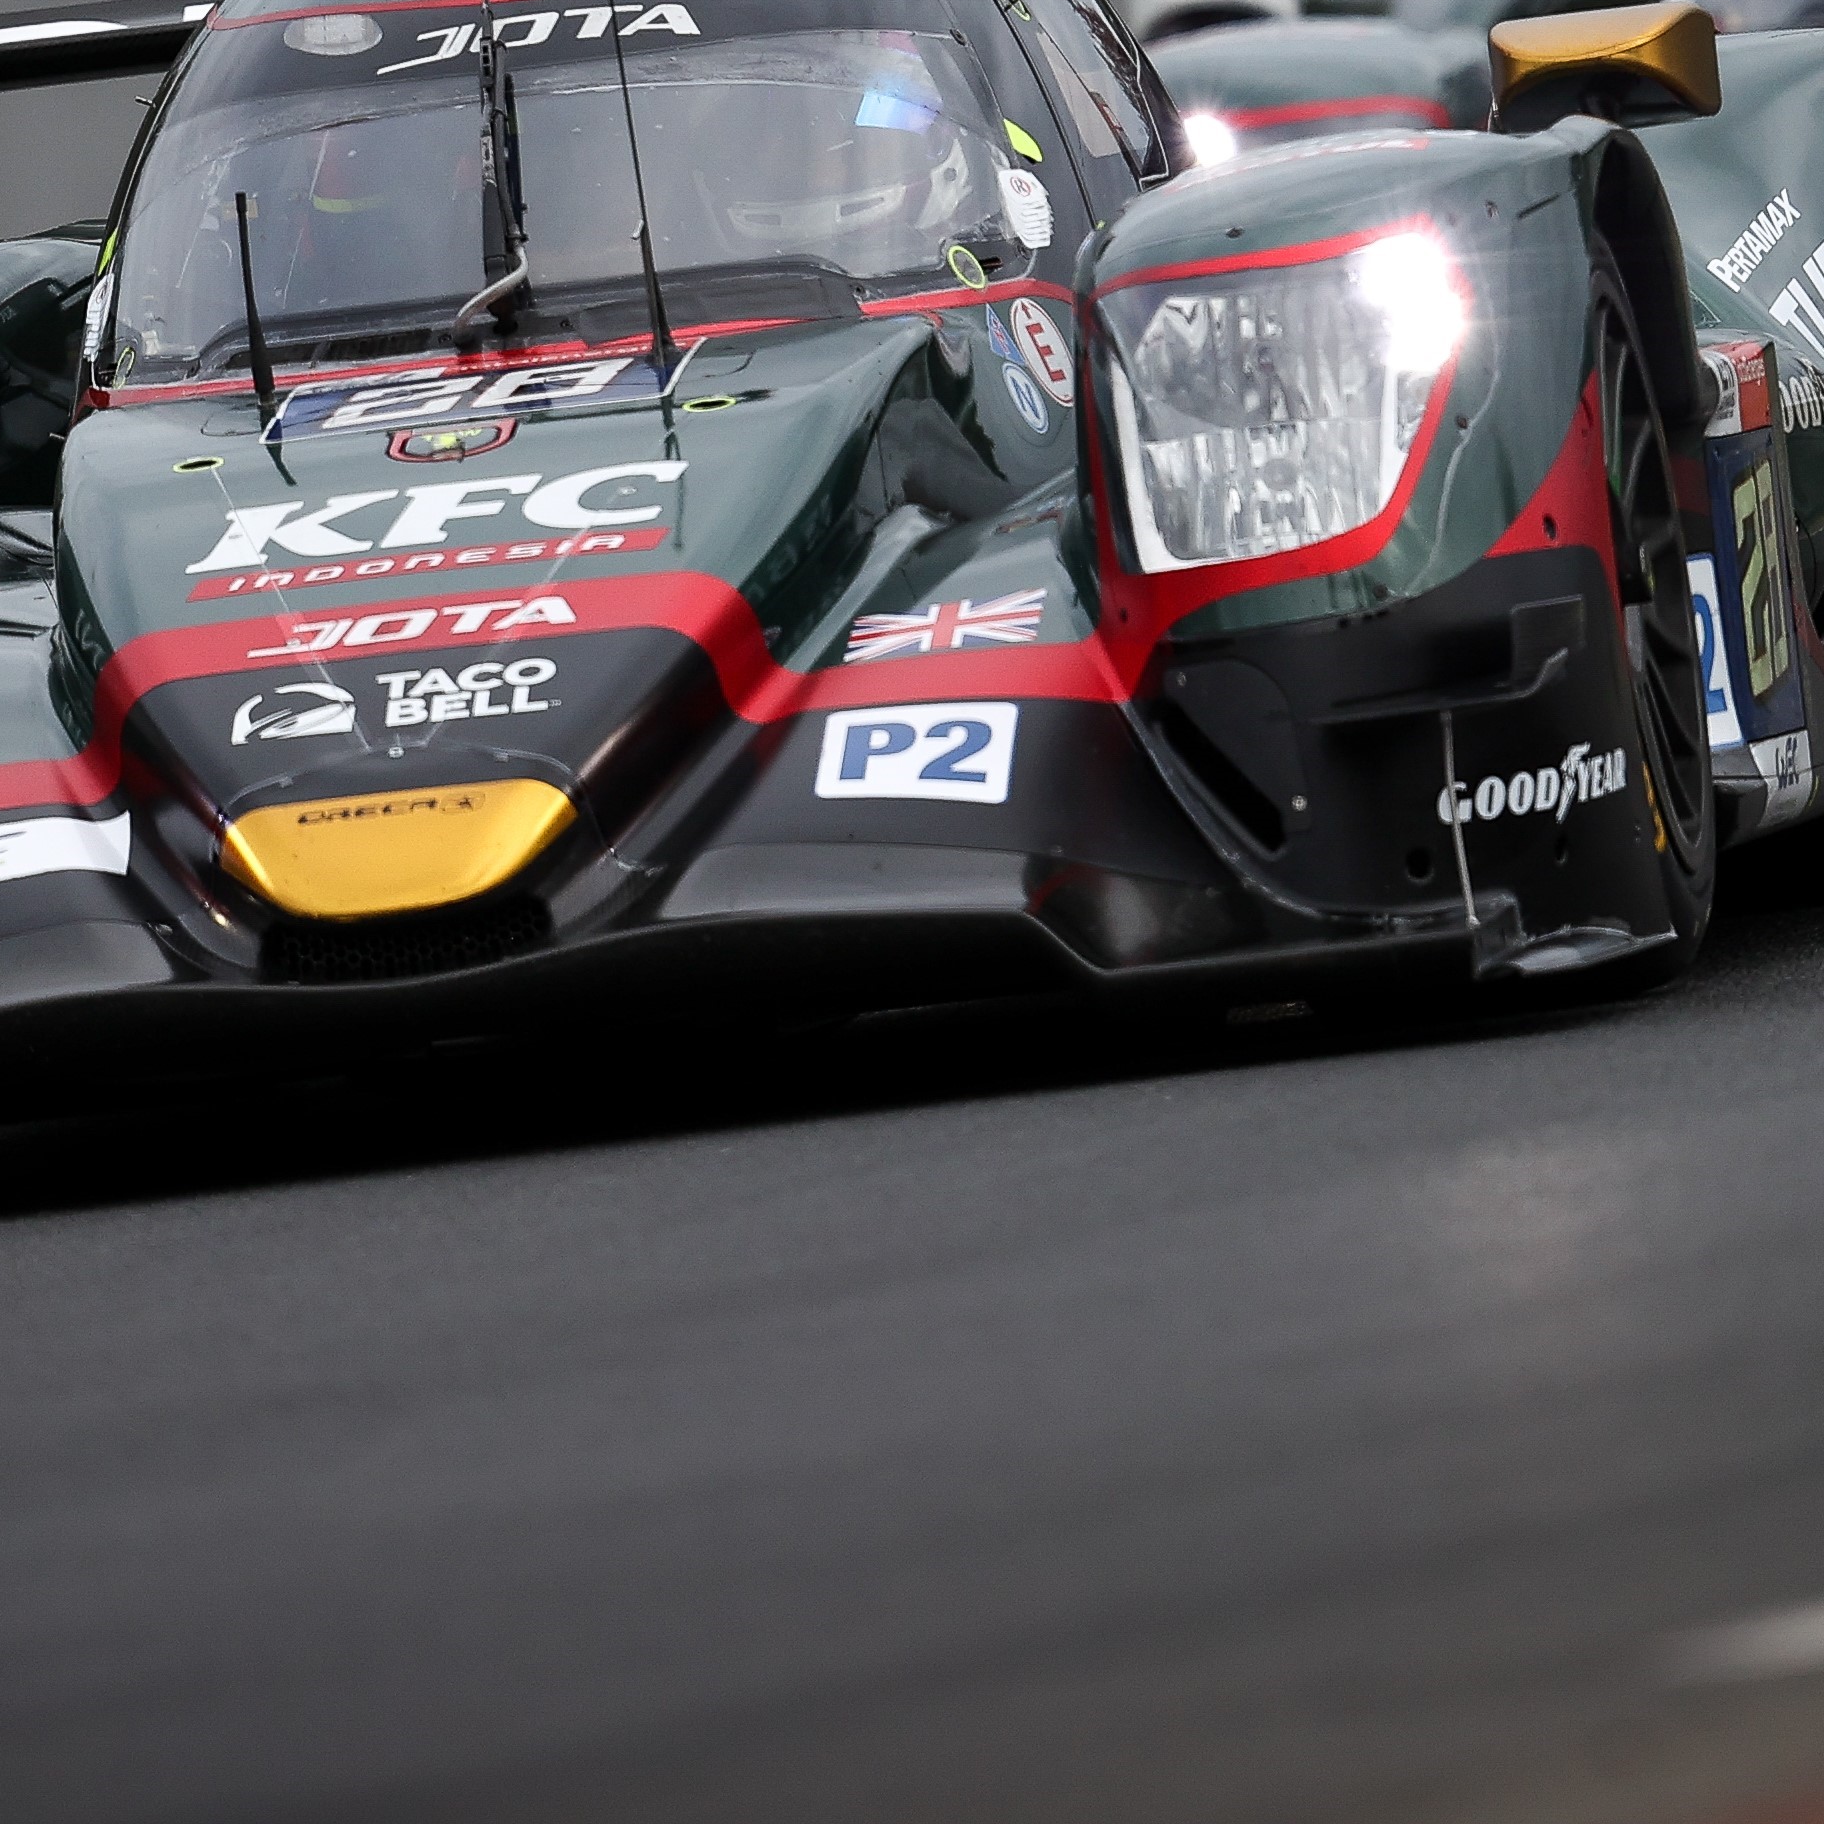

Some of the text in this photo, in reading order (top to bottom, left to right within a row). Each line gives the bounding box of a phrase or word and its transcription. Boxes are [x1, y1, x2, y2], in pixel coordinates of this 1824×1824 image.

[378, 2, 701, 74] JOTA
[1707, 188, 1801, 292] PERTAMAX
[185, 460, 689, 574] KFC
[227, 533, 626, 592] INDONESIA
[246, 595, 577, 659] JOTA
[376, 657, 557, 700] TACO
[386, 686, 550, 727] BELL
[839, 720, 992, 783] P2
[1436, 741, 1626, 825] GOODYEAR
